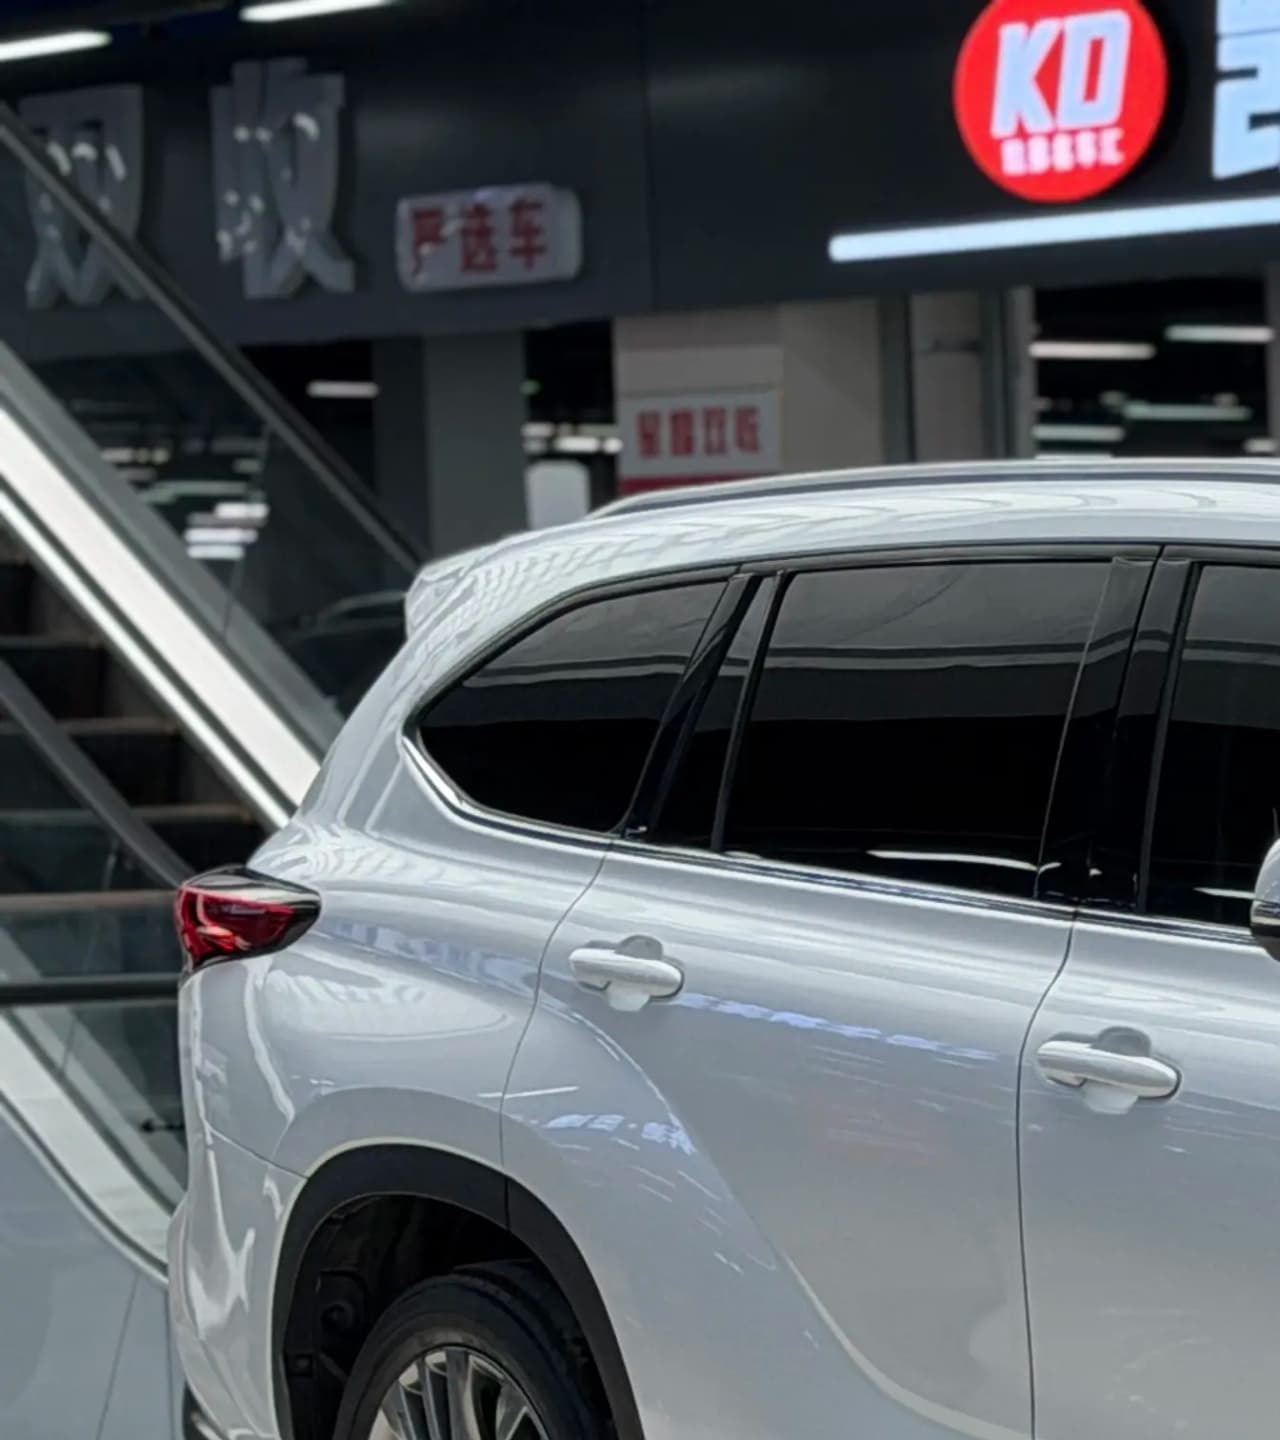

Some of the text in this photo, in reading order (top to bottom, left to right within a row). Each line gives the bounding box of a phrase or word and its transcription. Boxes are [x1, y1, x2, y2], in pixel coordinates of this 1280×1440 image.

[990, 9, 1131, 139] KD
[412, 196, 547, 275] 严选车
